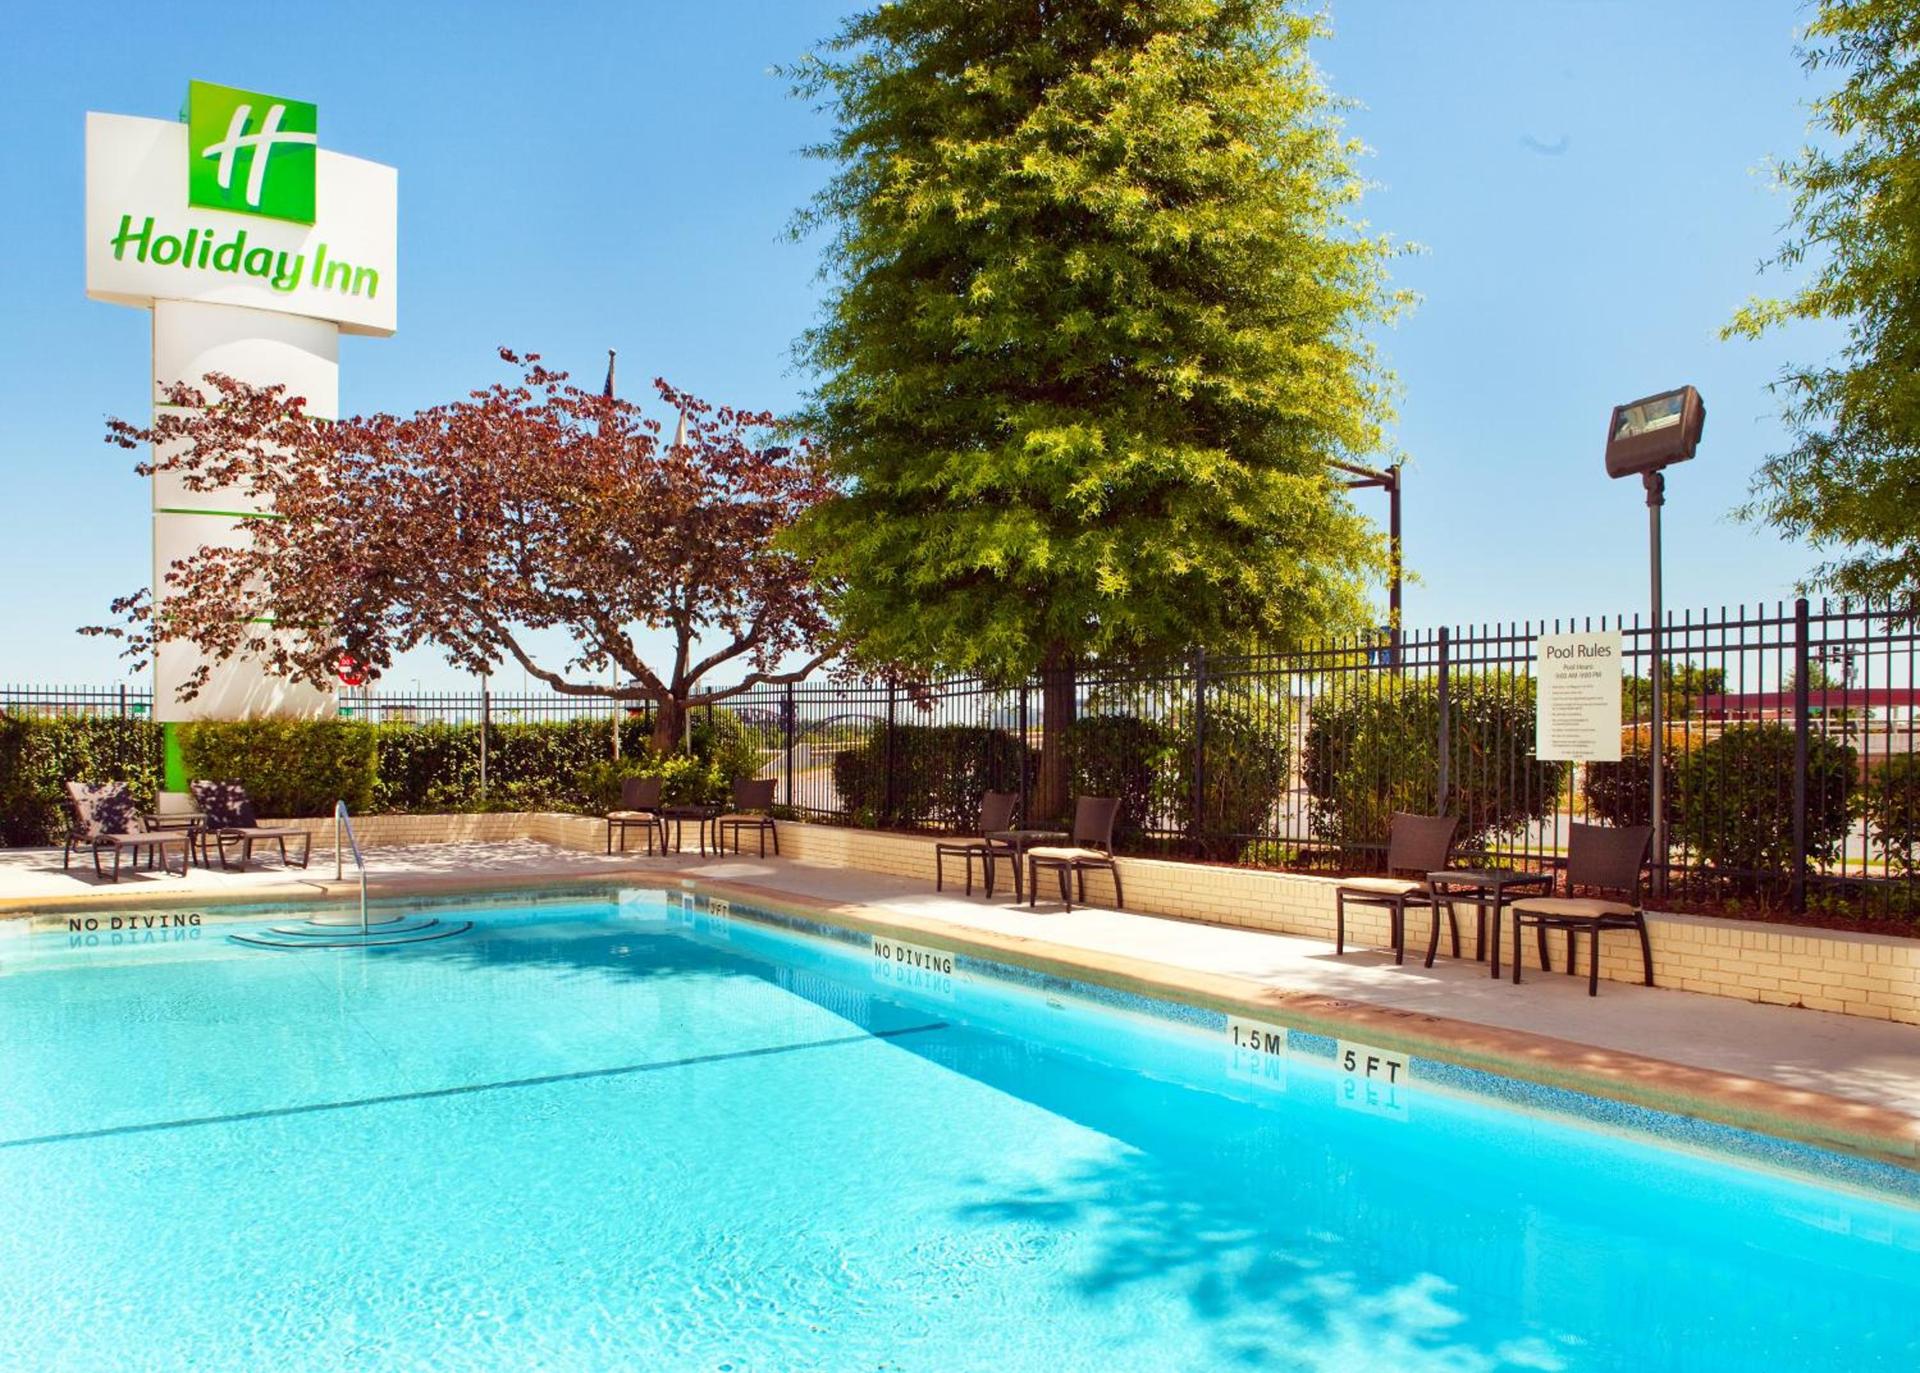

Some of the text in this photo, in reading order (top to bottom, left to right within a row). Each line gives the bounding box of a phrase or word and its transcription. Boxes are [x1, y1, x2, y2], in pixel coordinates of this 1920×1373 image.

[202, 103, 317, 206] H
[110, 214, 379, 298] Holiday Inn
[1546, 643, 1612, 659] Pool Rules
[69, 913, 201, 931] NO DIVING
[875, 942, 951, 974] NO DIVING
[1233, 1026, 1280, 1056] 1.5M
